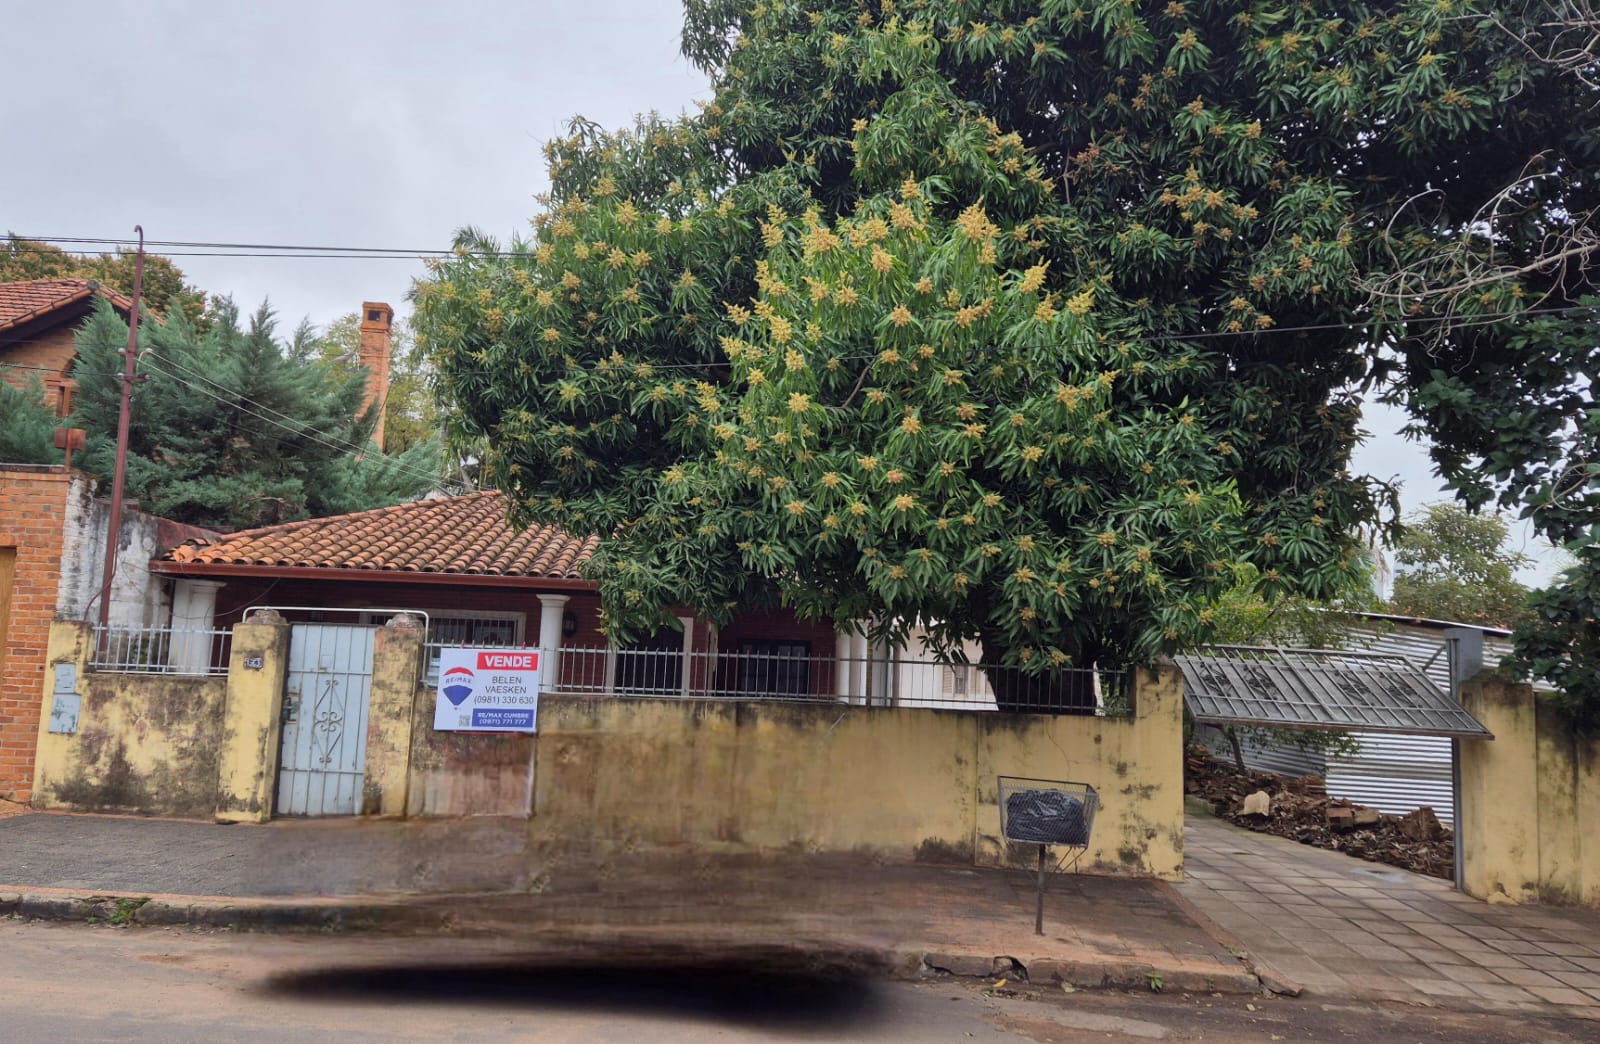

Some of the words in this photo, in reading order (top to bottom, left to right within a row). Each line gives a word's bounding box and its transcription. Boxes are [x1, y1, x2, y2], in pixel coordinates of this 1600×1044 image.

[484, 655, 532, 668] VENDE
[491, 676, 522, 684] BELEN
[485, 686, 527, 694] VAESKEN
[474, 696, 500, 705] (0981)
[502, 696, 517, 704] 330
[519, 697, 534, 705] 630
